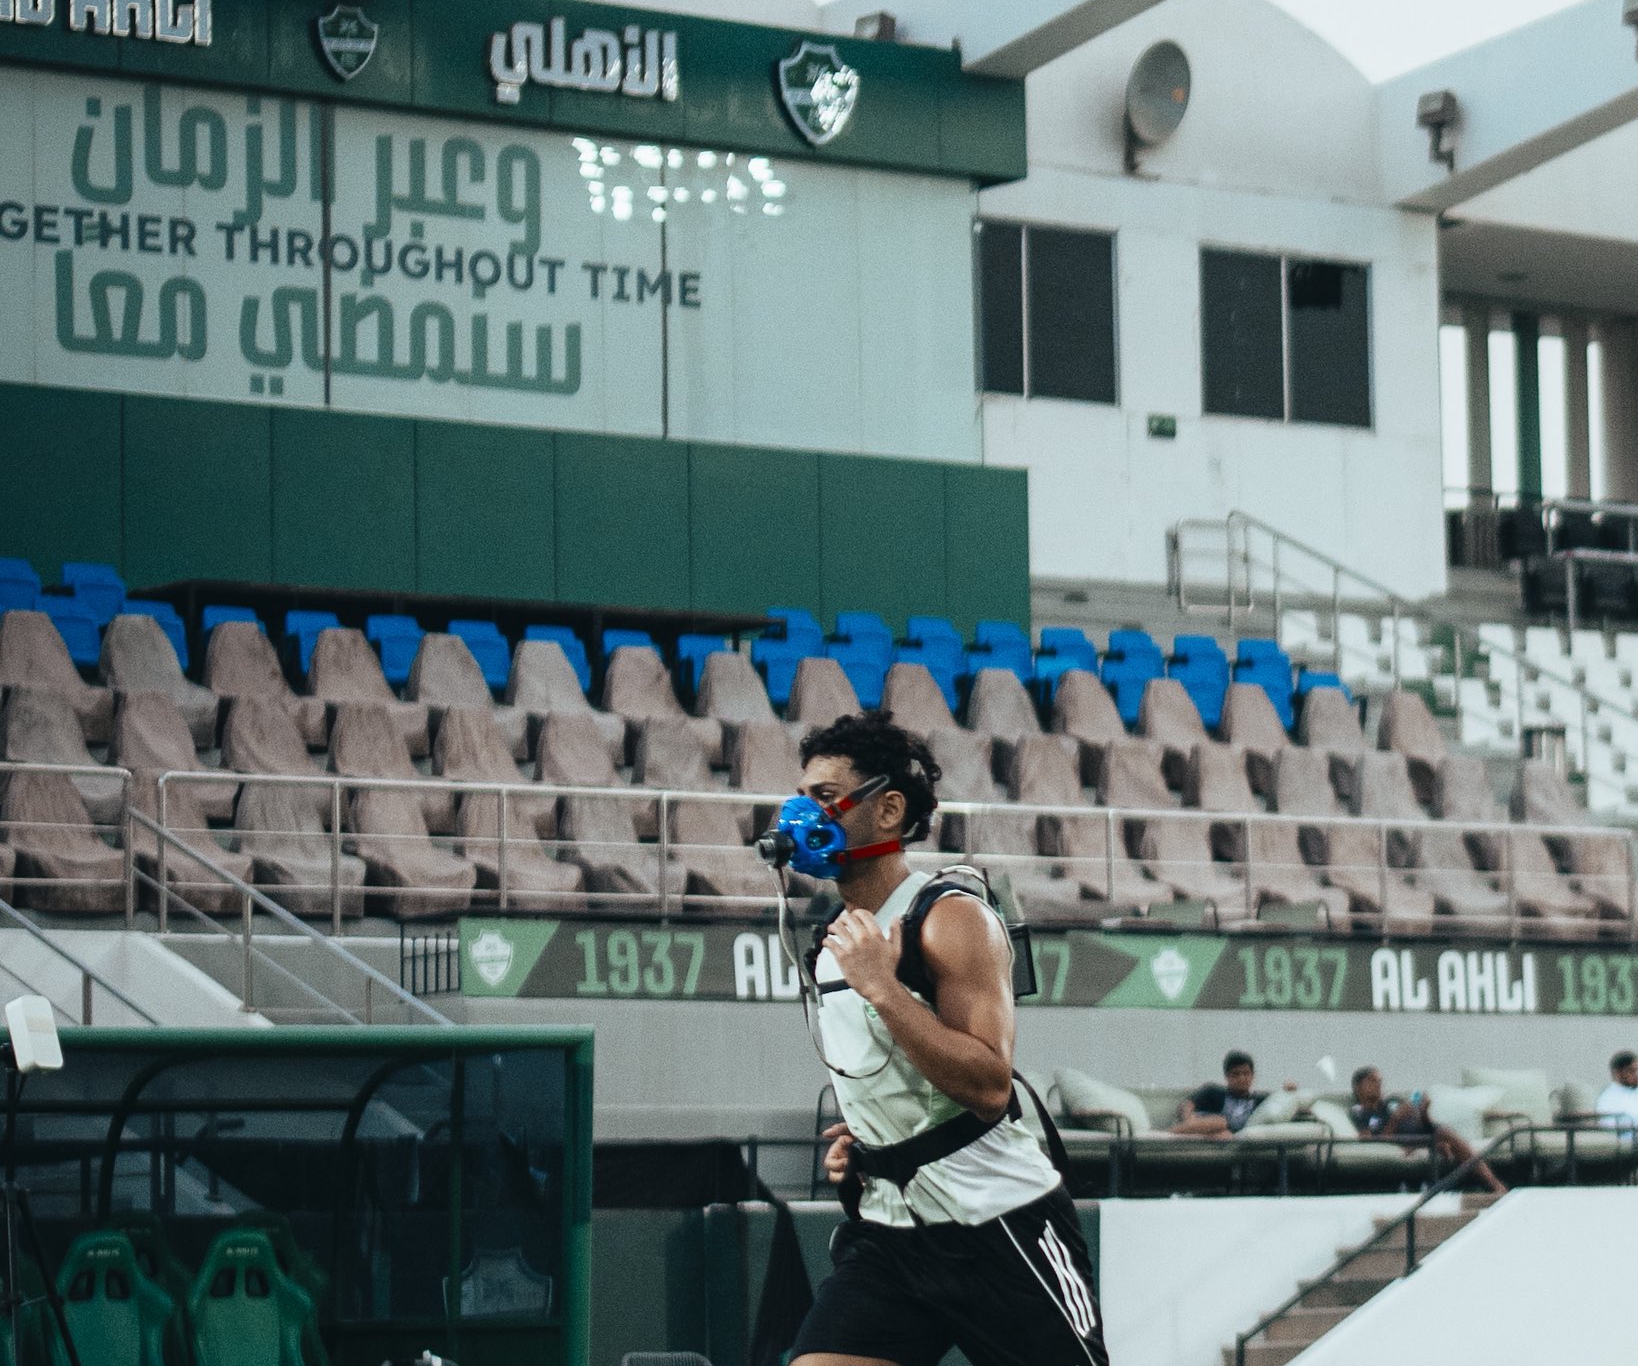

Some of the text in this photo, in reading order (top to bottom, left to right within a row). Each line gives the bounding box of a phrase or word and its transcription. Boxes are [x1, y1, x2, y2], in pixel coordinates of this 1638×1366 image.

[71, 85, 541, 256] وعبر الزمان
[216, 221, 566, 296] THROUGHOUT
[581, 259, 702, 309] TIME
[575, 929, 800, 1001] 1937 AL
[1237, 945, 1348, 1009] 1937
[1371, 947, 1430, 1012] AL
[1437, 949, 1537, 1013] AHLI
